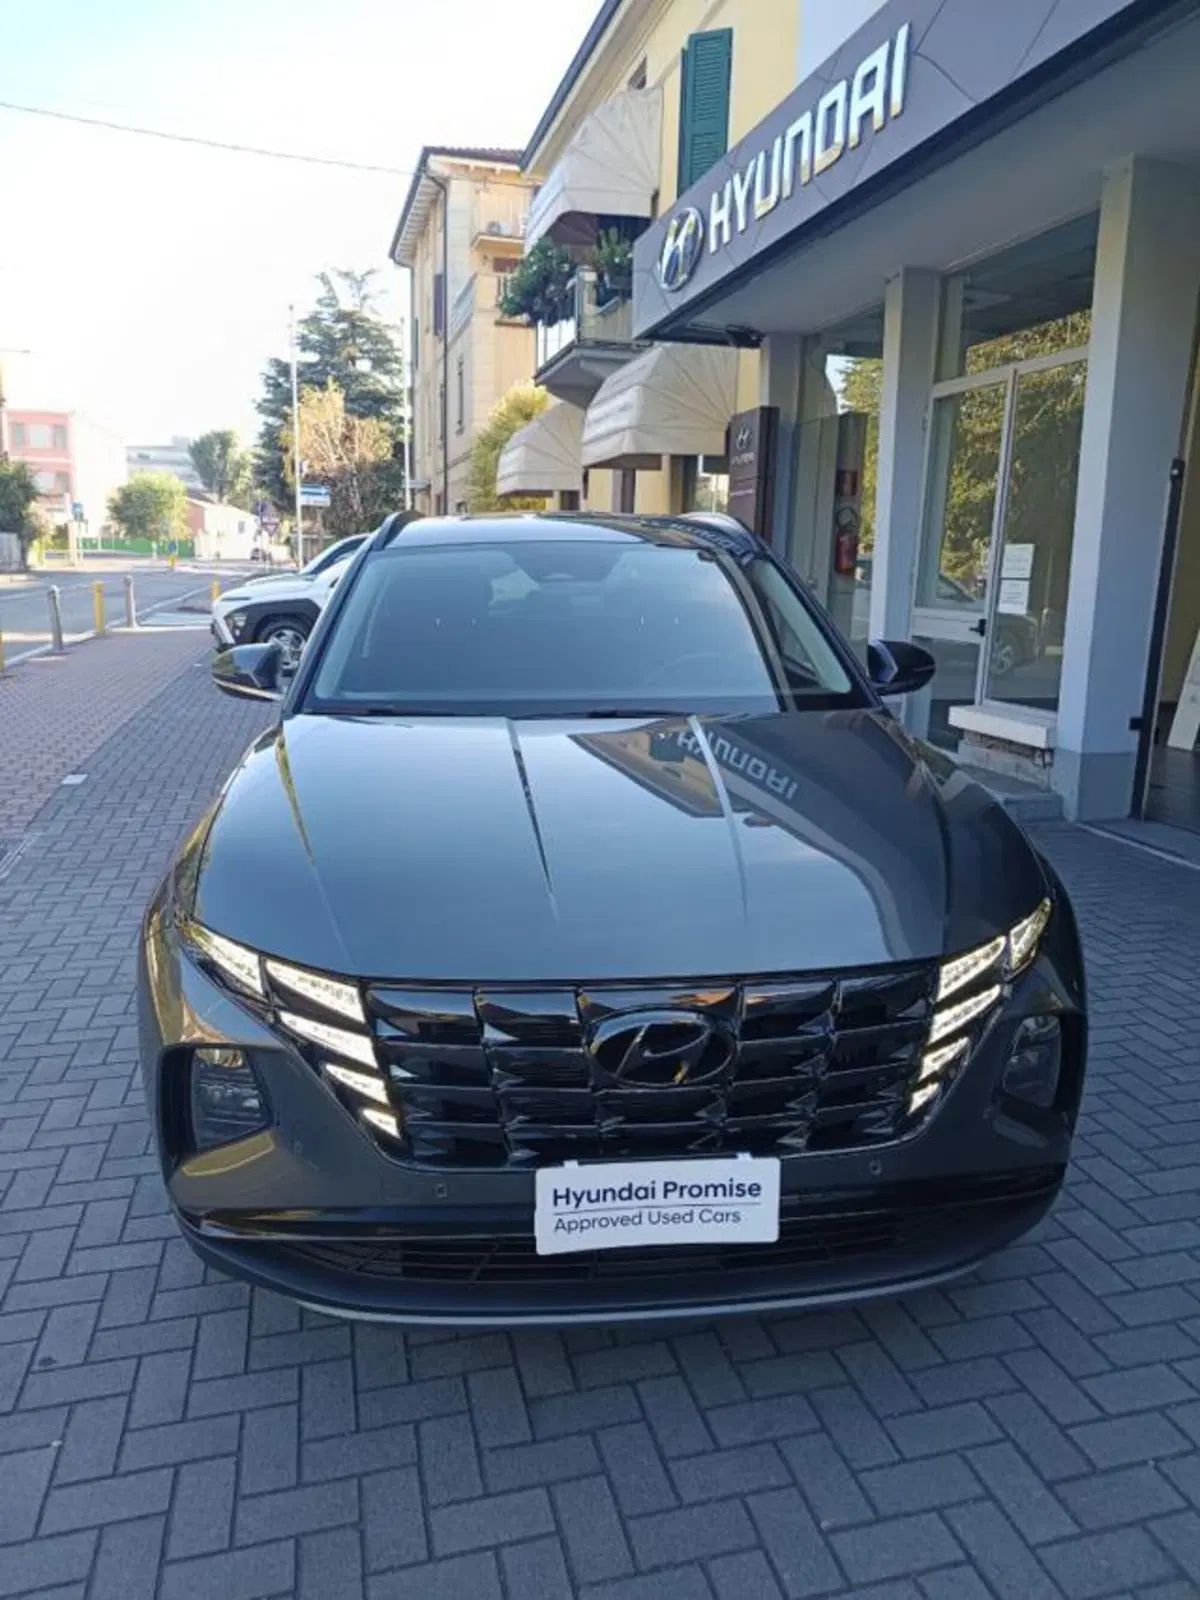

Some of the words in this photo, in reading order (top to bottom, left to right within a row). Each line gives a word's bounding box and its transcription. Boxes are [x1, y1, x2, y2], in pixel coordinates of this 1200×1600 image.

[709, 22, 909, 254] HYUNDAI
[552, 1180, 656, 1209] Hyundai
[662, 1178, 762, 1199] Promise
[553, 1210, 643, 1234] Approved
[647, 1209, 694, 1226] Used
[698, 1208, 742, 1225] Cars
